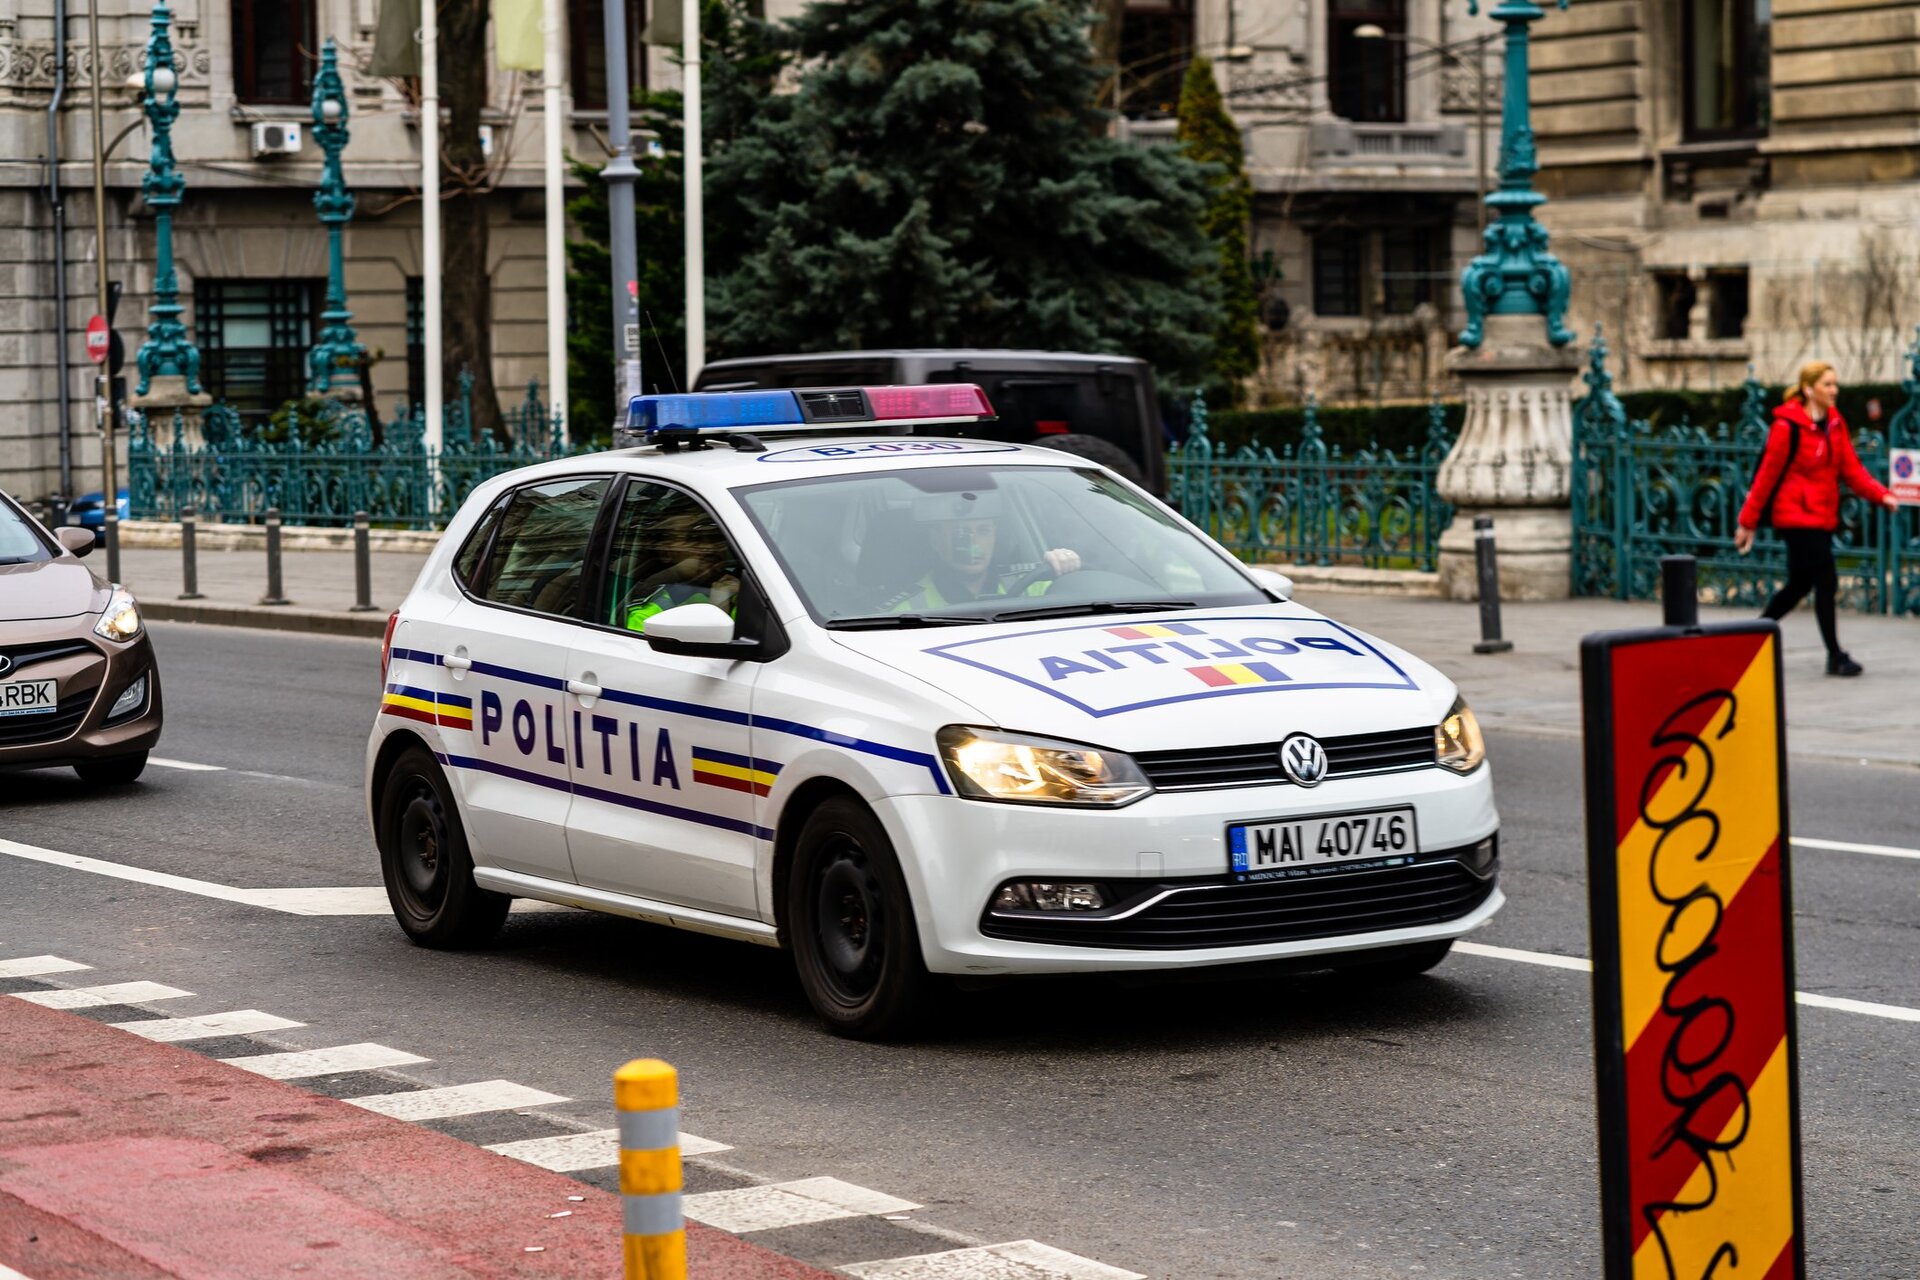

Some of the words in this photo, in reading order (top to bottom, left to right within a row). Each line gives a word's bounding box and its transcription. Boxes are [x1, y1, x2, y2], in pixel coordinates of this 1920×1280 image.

[809, 440, 965, 457] B-030
[0, 682, 50, 707] RBK
[480, 689, 681, 791] POLITIA
[1254, 825, 1305, 865] MAI
[1316, 815, 1407, 857] 40746
